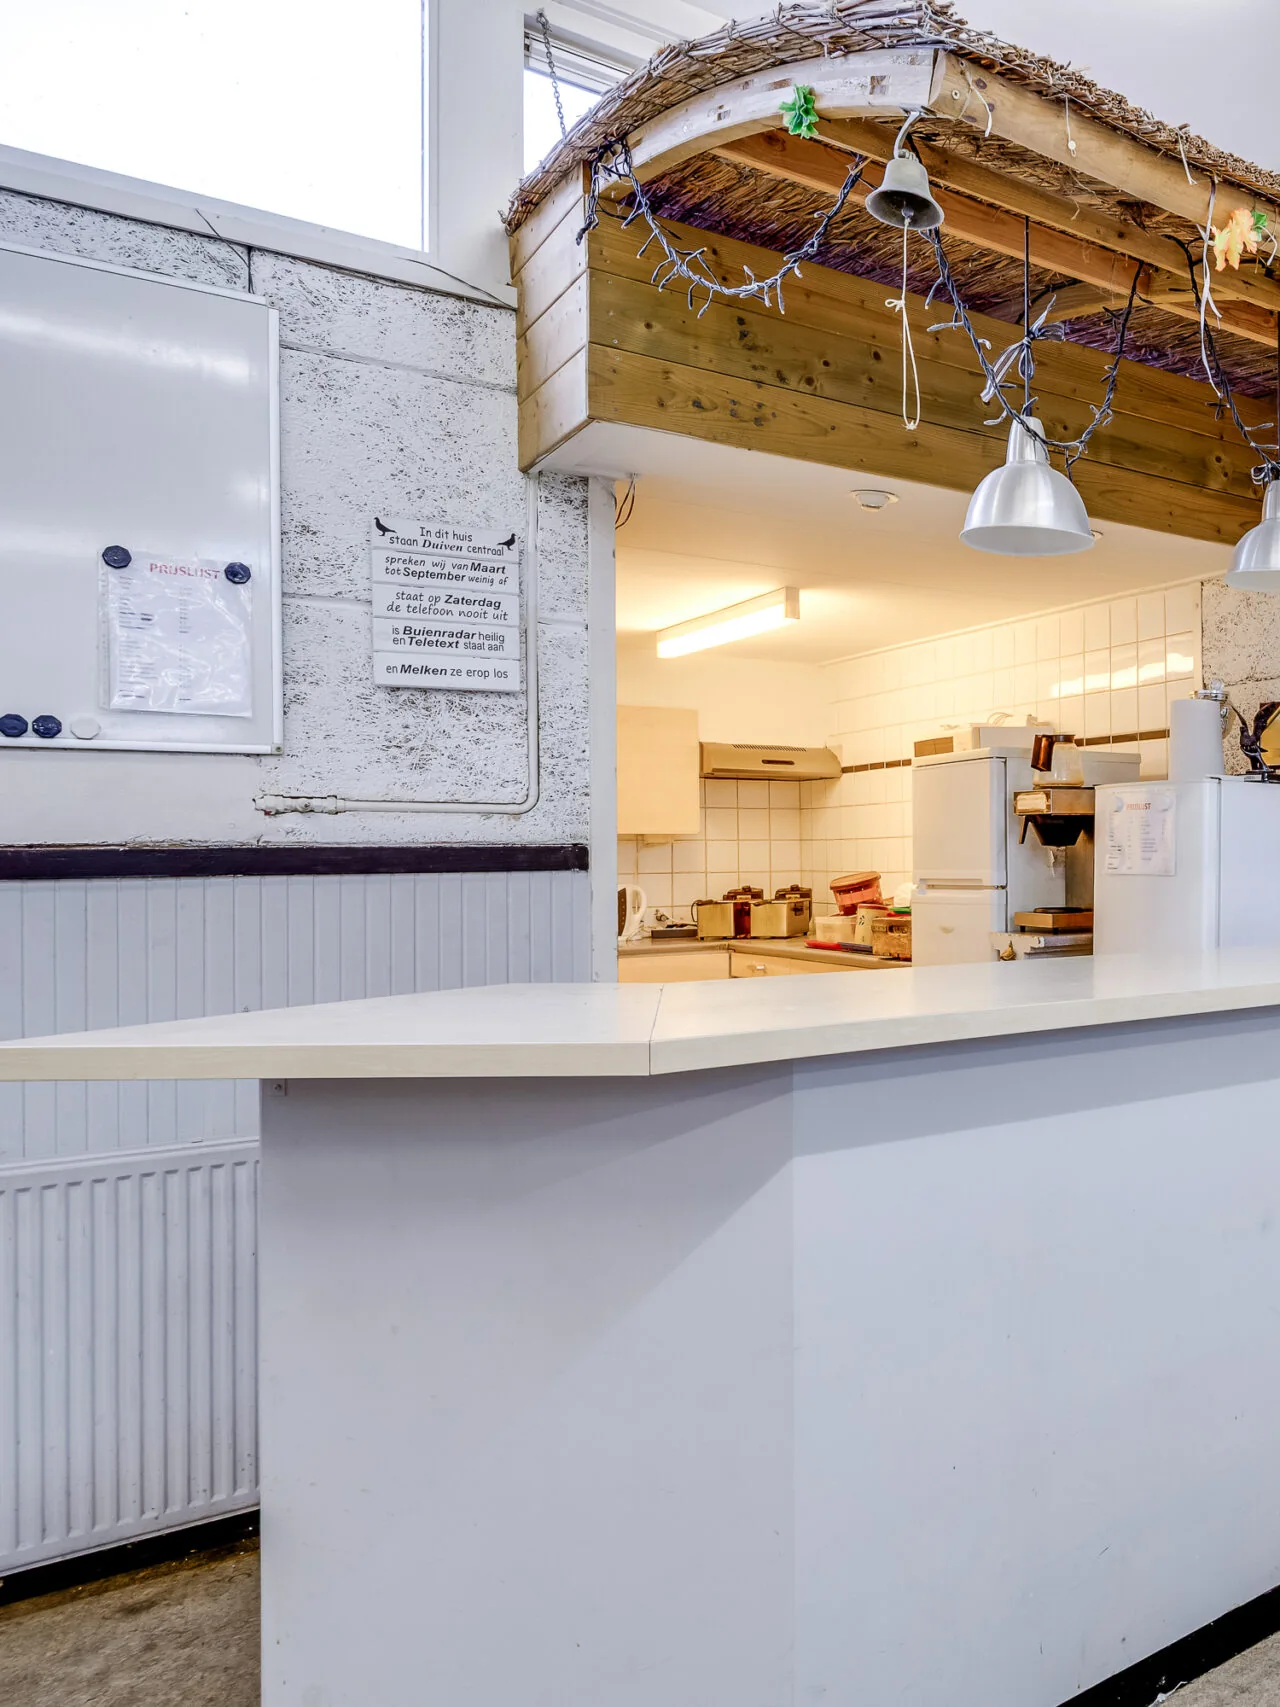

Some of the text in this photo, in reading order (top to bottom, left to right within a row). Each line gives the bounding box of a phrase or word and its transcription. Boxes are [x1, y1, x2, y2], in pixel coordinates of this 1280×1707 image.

[420, 527, 473, 542] In dit huis
[389, 535, 504, 556] staan Duiven centraal
[385, 556, 506, 574] spreken wij van Maart
[385, 566, 401, 576] tot
[403, 568, 465, 582] September
[468, 574, 494, 586] weinig
[396, 591, 501, 610] staat op Zaterdag
[387, 601, 508, 621] de telefoon nooit uit
[392, 625, 505, 643] is Buienradar heilig
[392, 637, 504, 651] en Teletext staat aan
[386, 664, 508, 682] en Melken ze erop los
